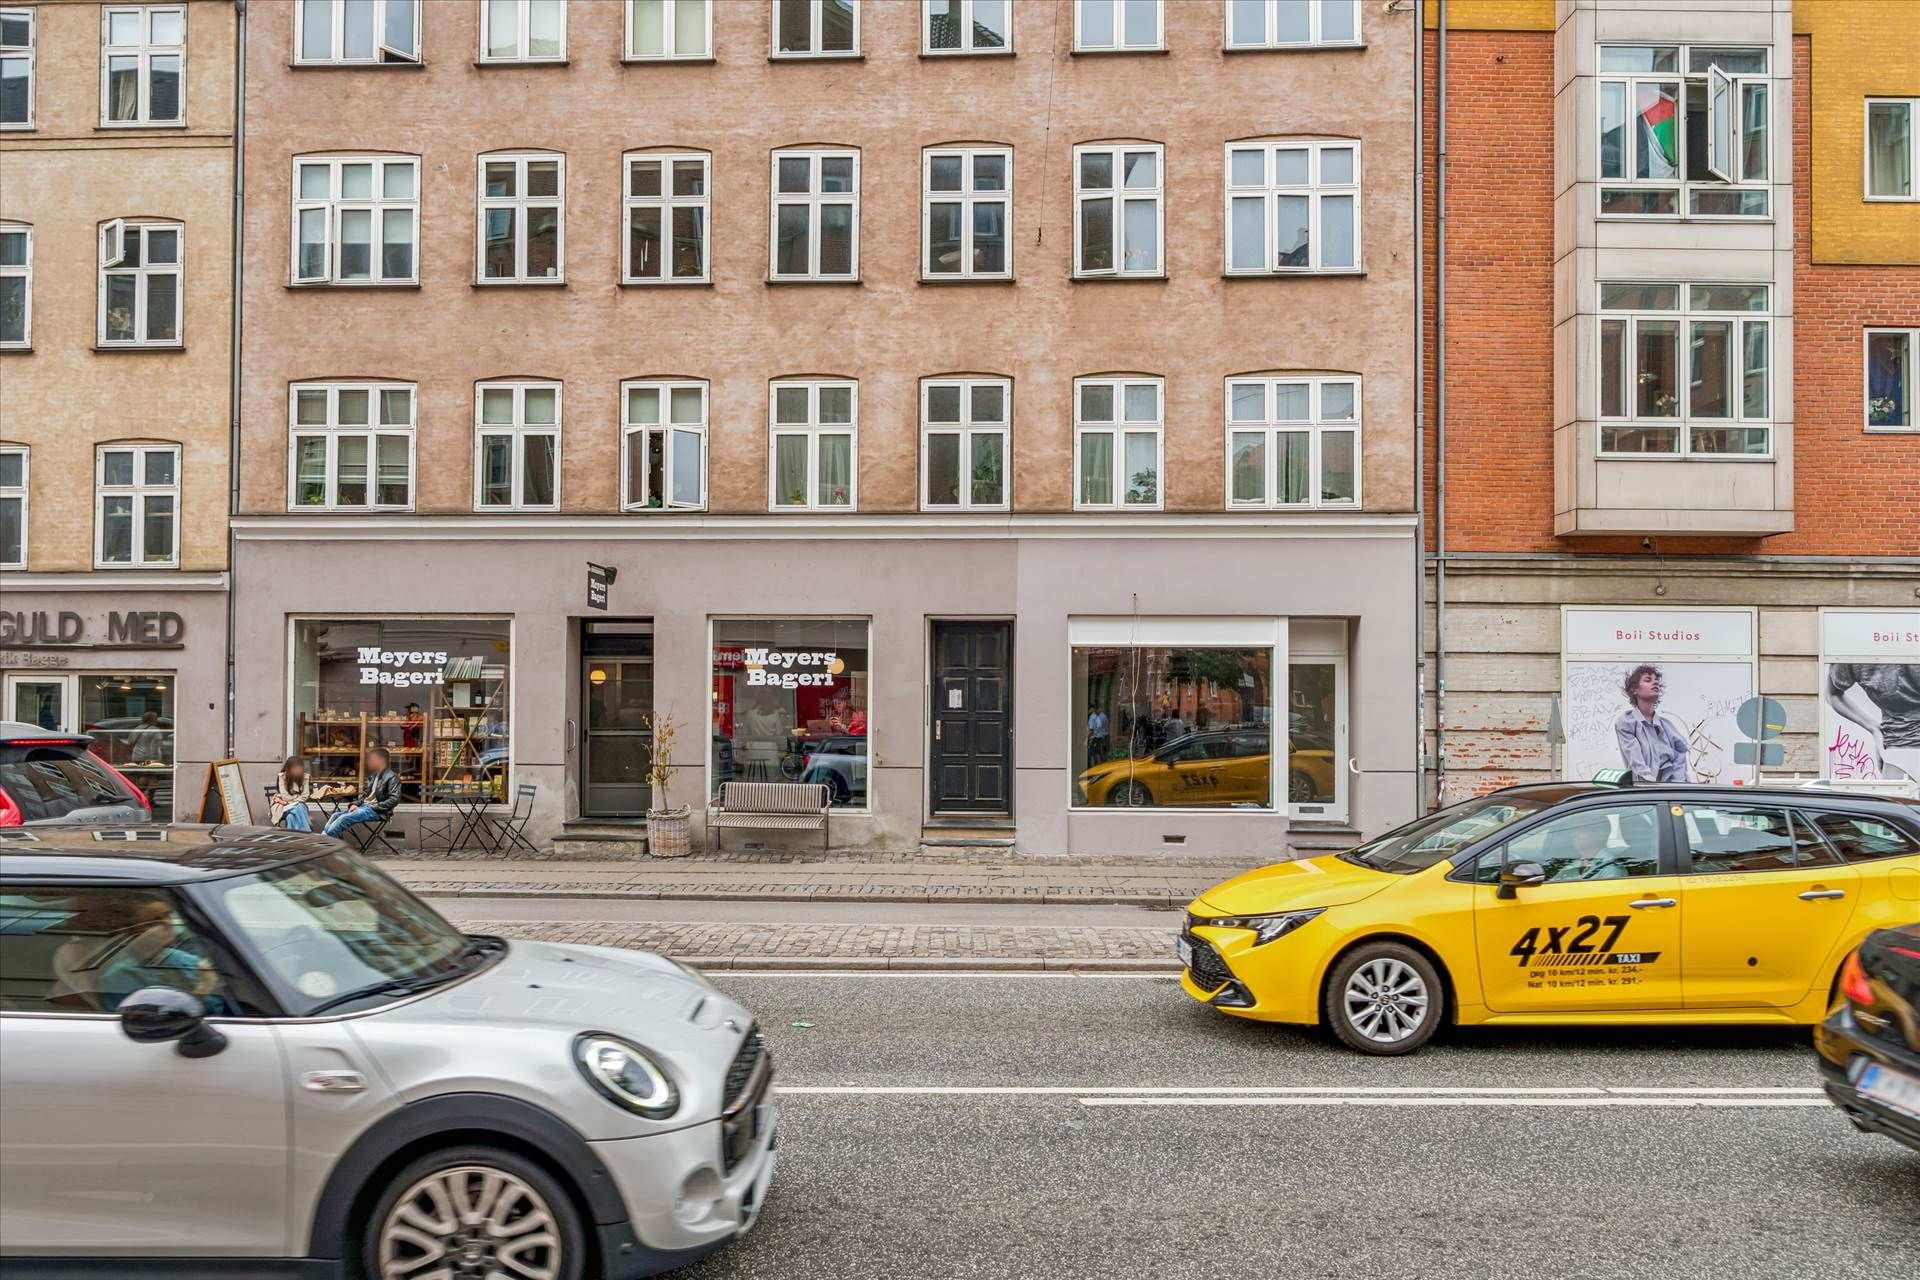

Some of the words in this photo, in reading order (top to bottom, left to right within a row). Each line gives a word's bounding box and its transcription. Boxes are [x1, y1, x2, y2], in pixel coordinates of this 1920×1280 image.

[107, 611, 185, 643] MED
[1616, 630, 1642, 641] Boii
[1649, 629, 1700, 641] Studios
[1873, 631, 1899, 641] Boii
[357, 647, 448, 667] Meyers
[744, 648, 837, 668] Meyers
[359, 668, 445, 688] Bageri
[746, 669, 834, 689] Bageri
[1616, 953, 1641, 963] TAXI
[1547, 980, 1558, 988] 10
